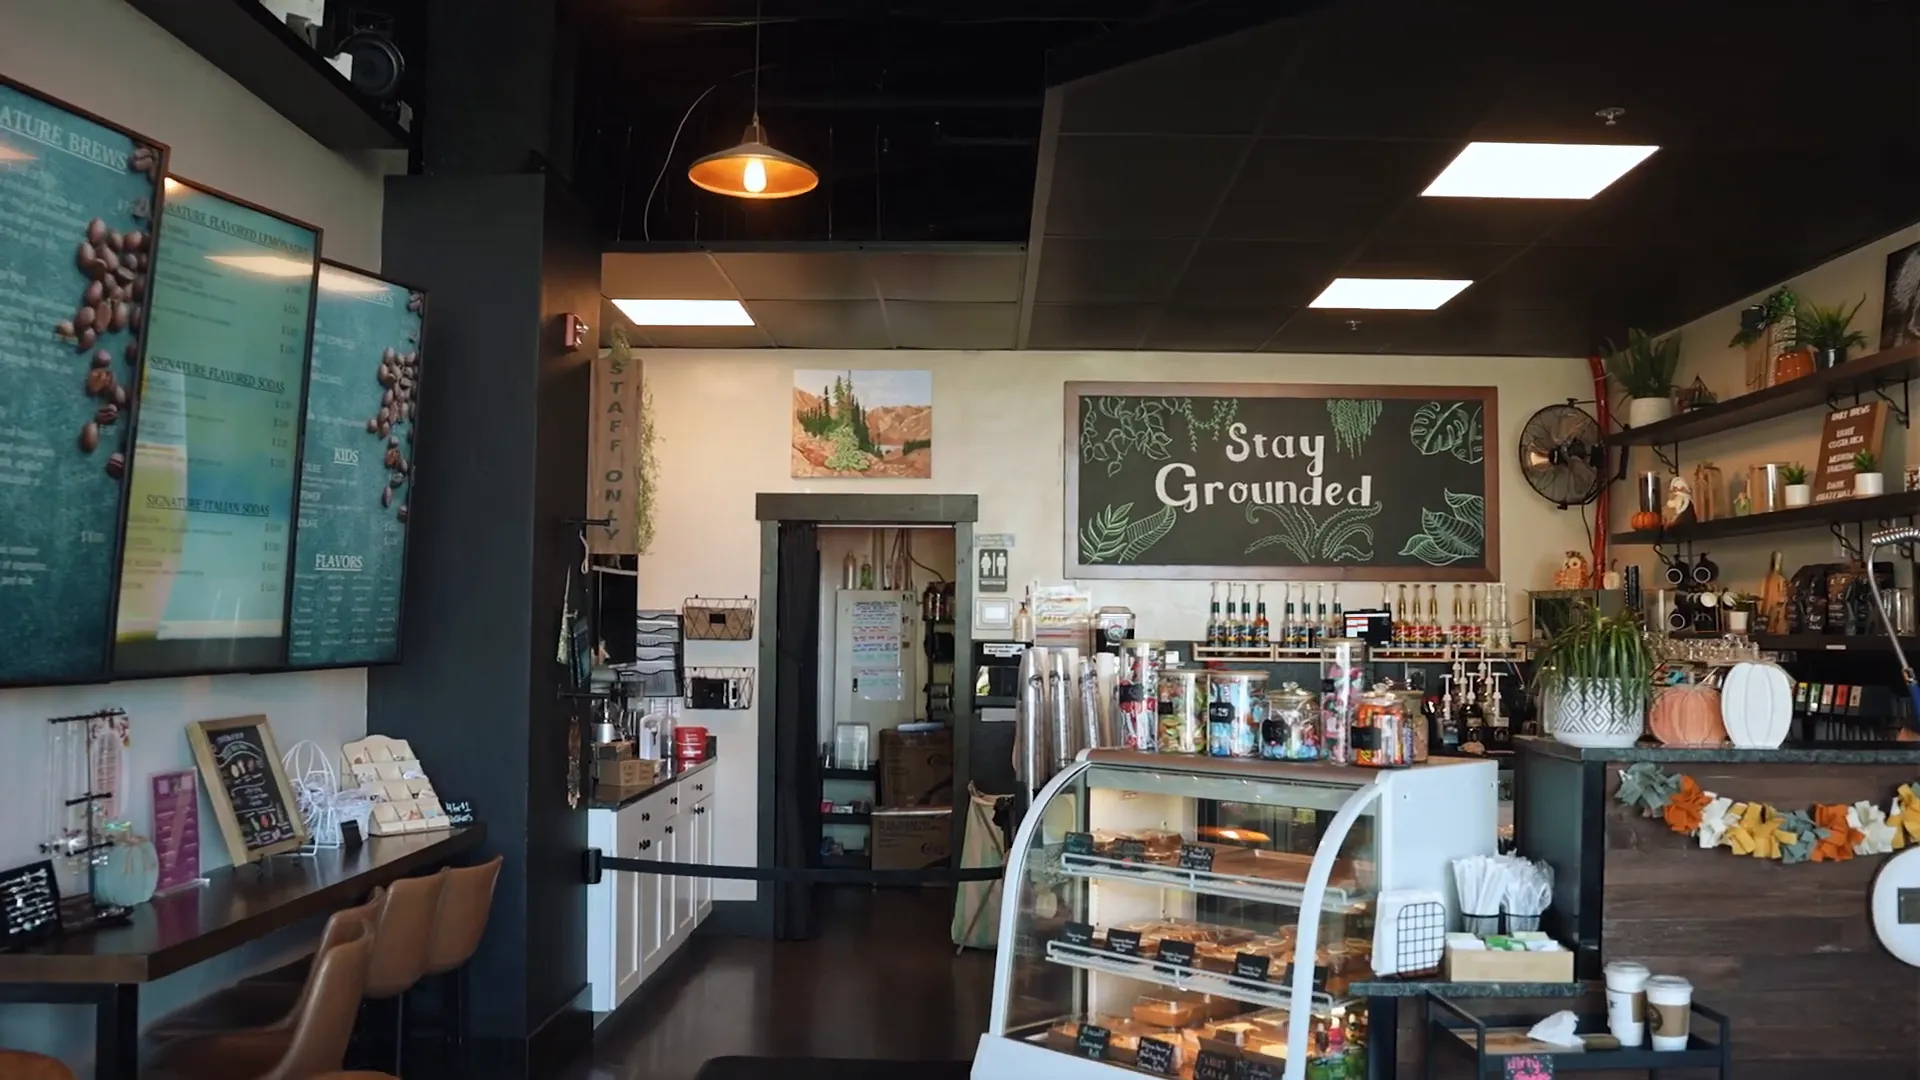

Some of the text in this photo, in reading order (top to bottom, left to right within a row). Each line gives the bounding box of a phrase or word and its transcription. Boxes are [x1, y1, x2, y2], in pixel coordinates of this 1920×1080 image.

[68, 131, 128, 170] BREWS
[209, 211, 257, 239] FLAVORED
[149, 355, 286, 392] SIGNATURE FLAVORED SODAS
[334, 447, 360, 463] KIDS
[604, 359, 624, 541] STAFF ONLY
[1225, 422, 1325, 477] Stay
[146, 493, 200, 511] SIGNATURE
[242, 504, 270, 516] SODAS
[1155, 462, 1372, 513] Grounded
[315, 553, 364, 569] FLAVORS
